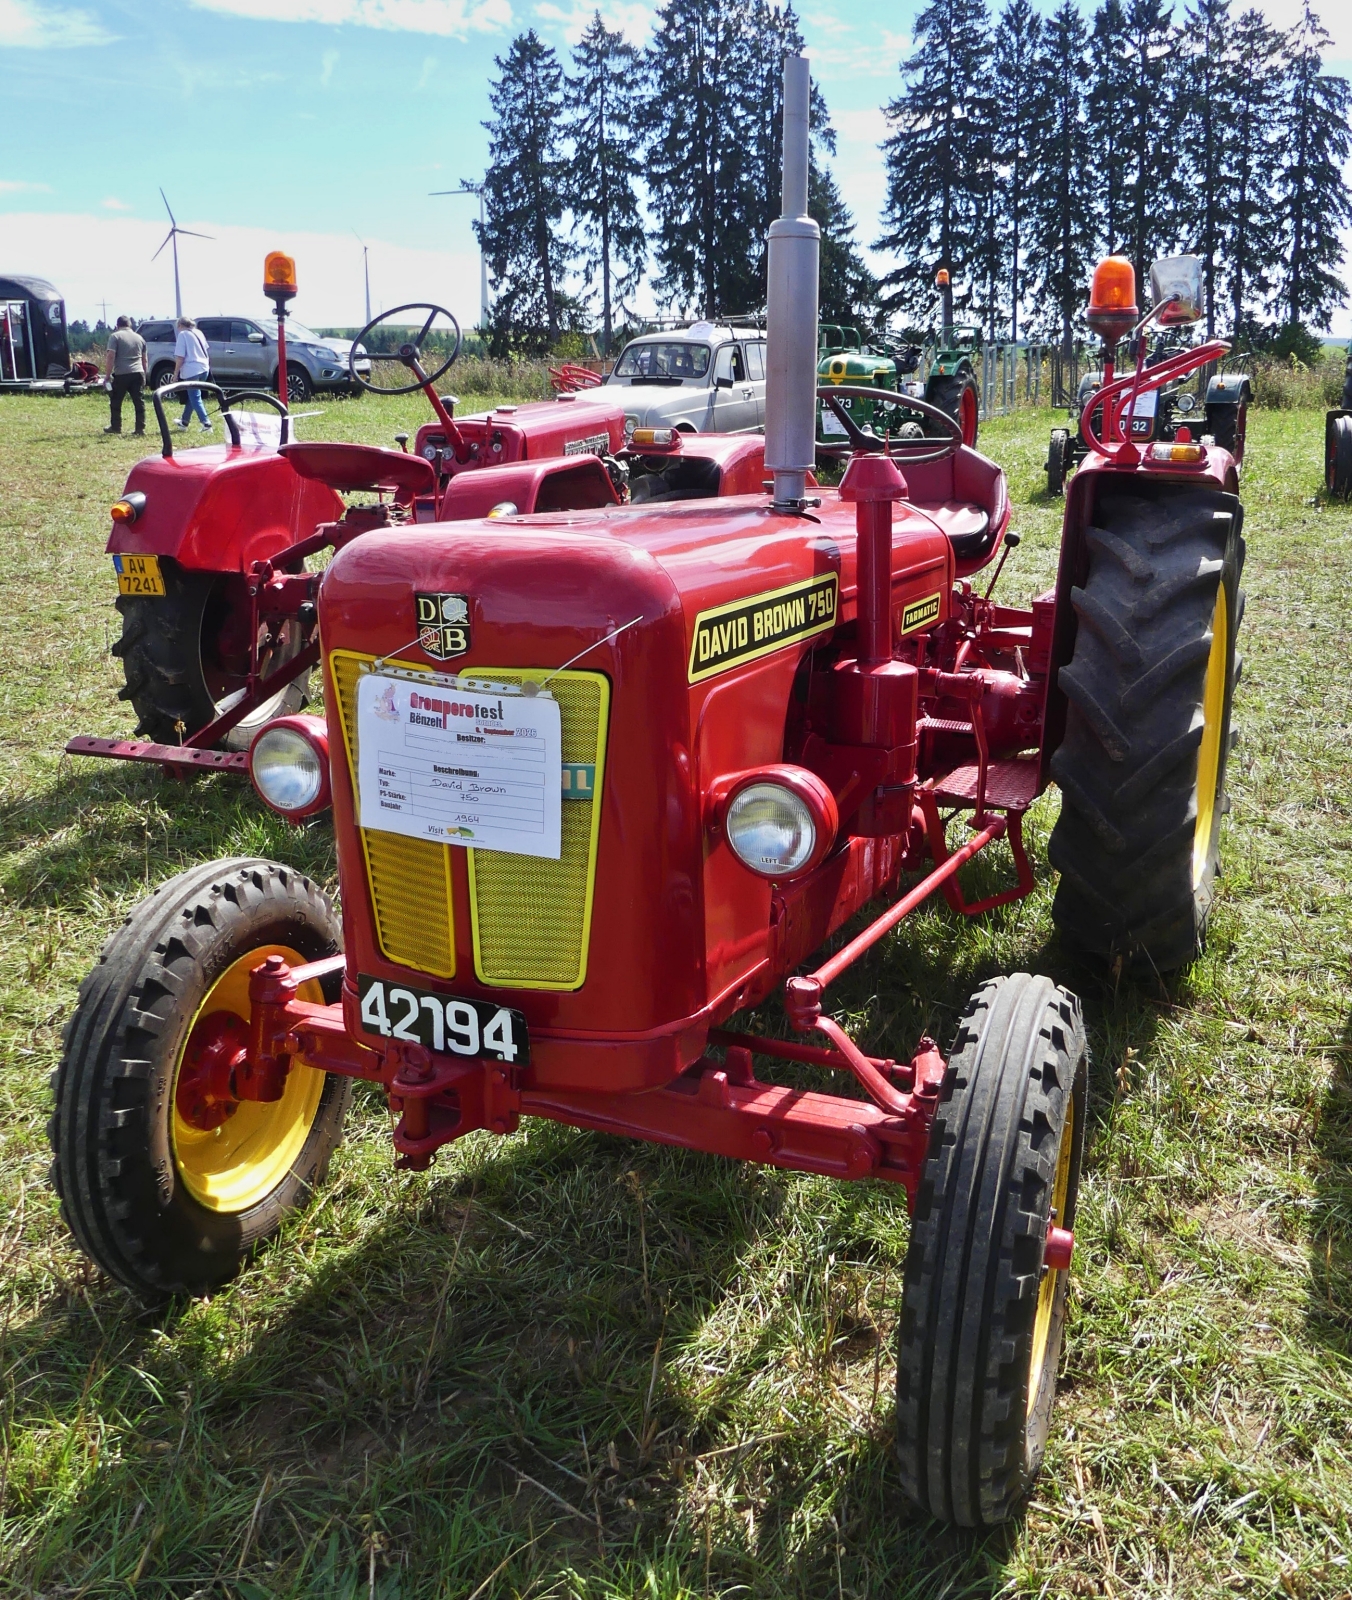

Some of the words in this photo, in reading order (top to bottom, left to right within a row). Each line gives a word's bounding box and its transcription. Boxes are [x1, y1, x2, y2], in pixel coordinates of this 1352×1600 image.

[129, 558, 146, 574] AW
[123, 576, 158, 592] 7241
[905, 601, 938, 625] FARMATIC
[699, 616, 748, 662] DAVID
[753, 597, 806, 642] BROWN
[809, 587, 834, 620] 750
[410, 711, 443, 729] Bënzelt
[457, 733, 486, 744] Besitzer:
[433, 764, 480, 778] Beschreibung:
[429, 778, 463, 791] David
[468, 783, 507, 793] Brown
[460, 793, 479, 802] 750
[454, 814, 480, 823] 1964
[428, 825, 444, 835] Visit
[360, 981, 518, 1062] 42194
